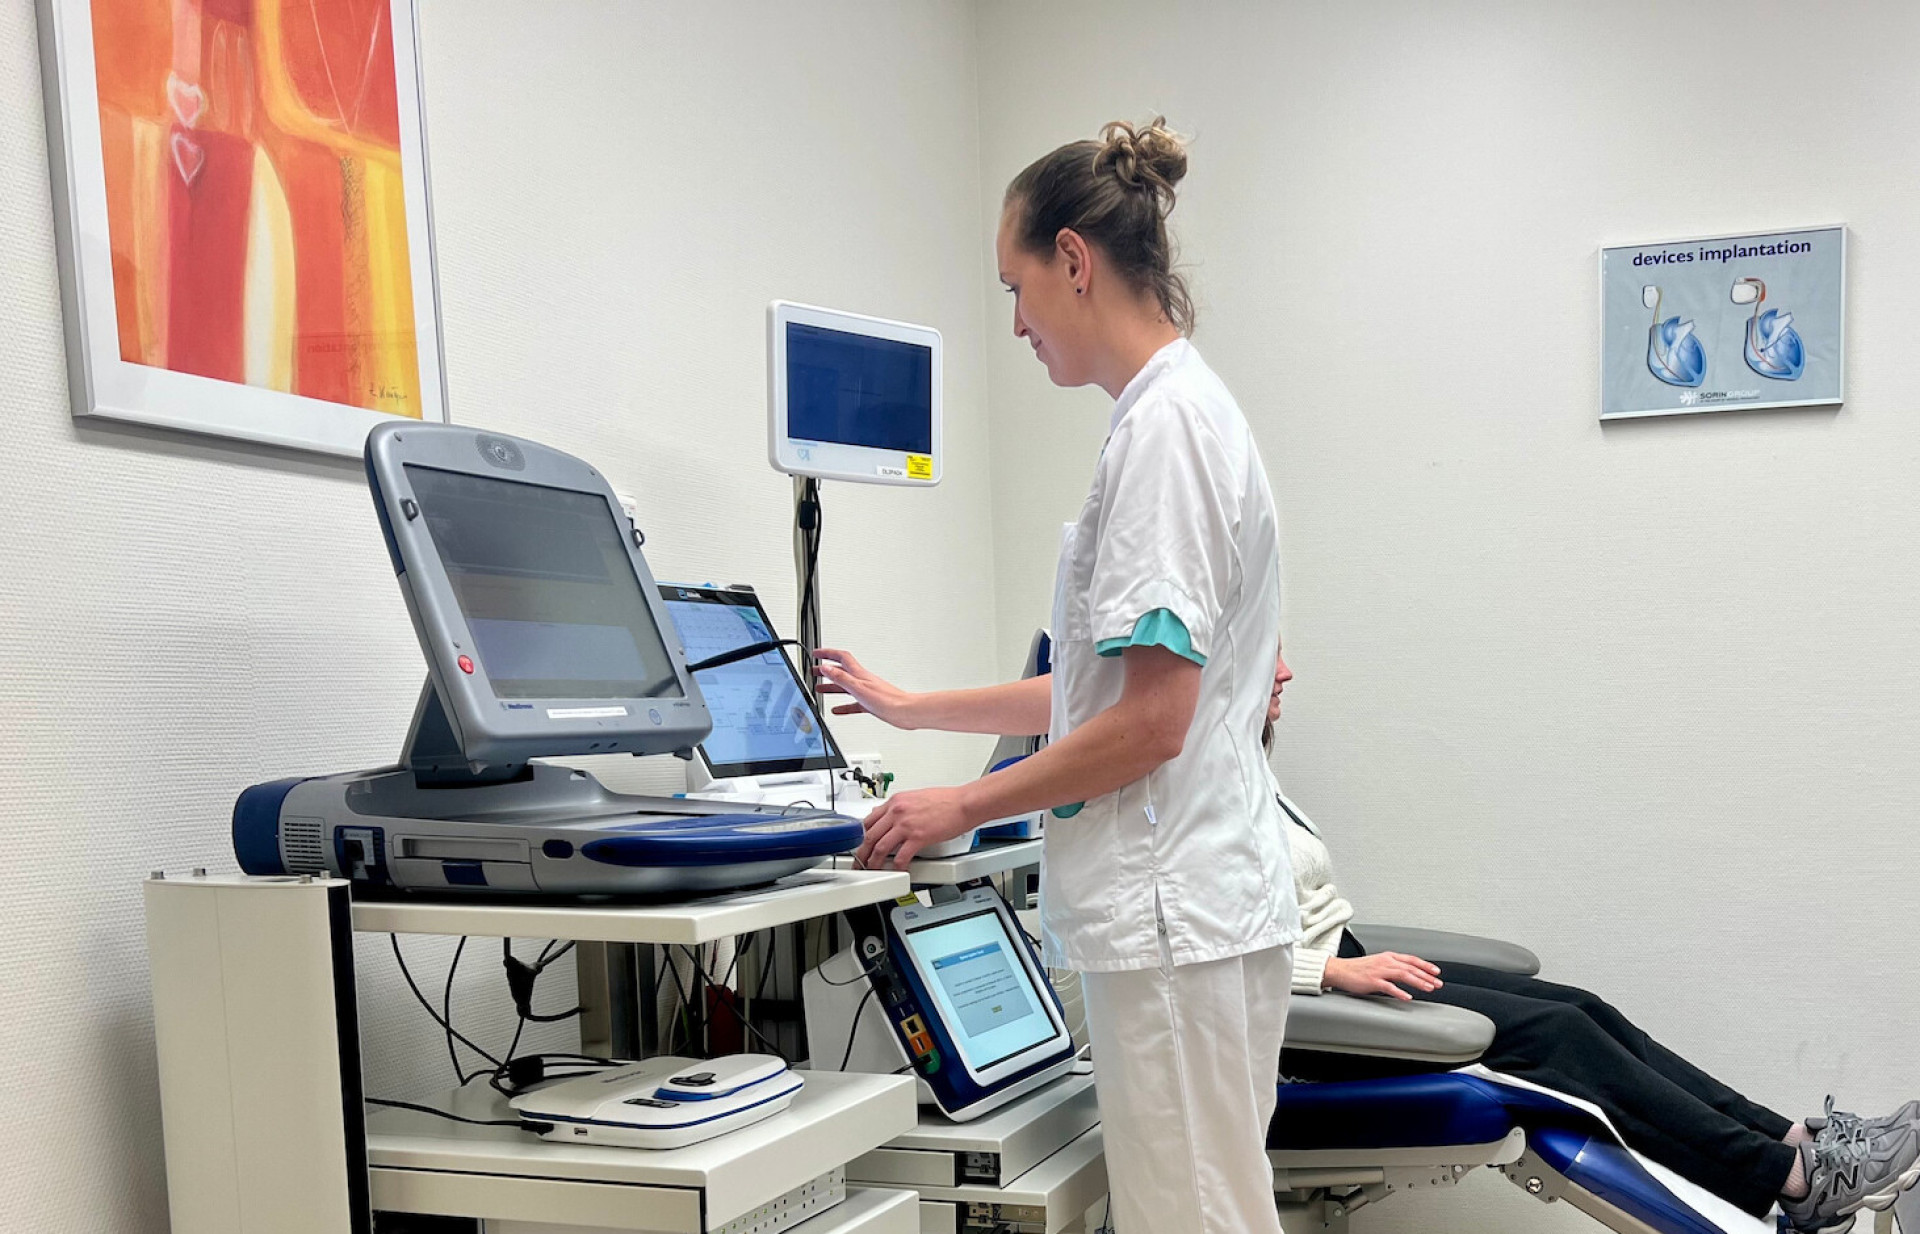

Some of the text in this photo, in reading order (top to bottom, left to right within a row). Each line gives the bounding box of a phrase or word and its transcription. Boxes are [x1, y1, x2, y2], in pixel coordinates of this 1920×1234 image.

[1633, 239, 1811, 266] devices implantation
[1832, 1164, 1859, 1195] N
